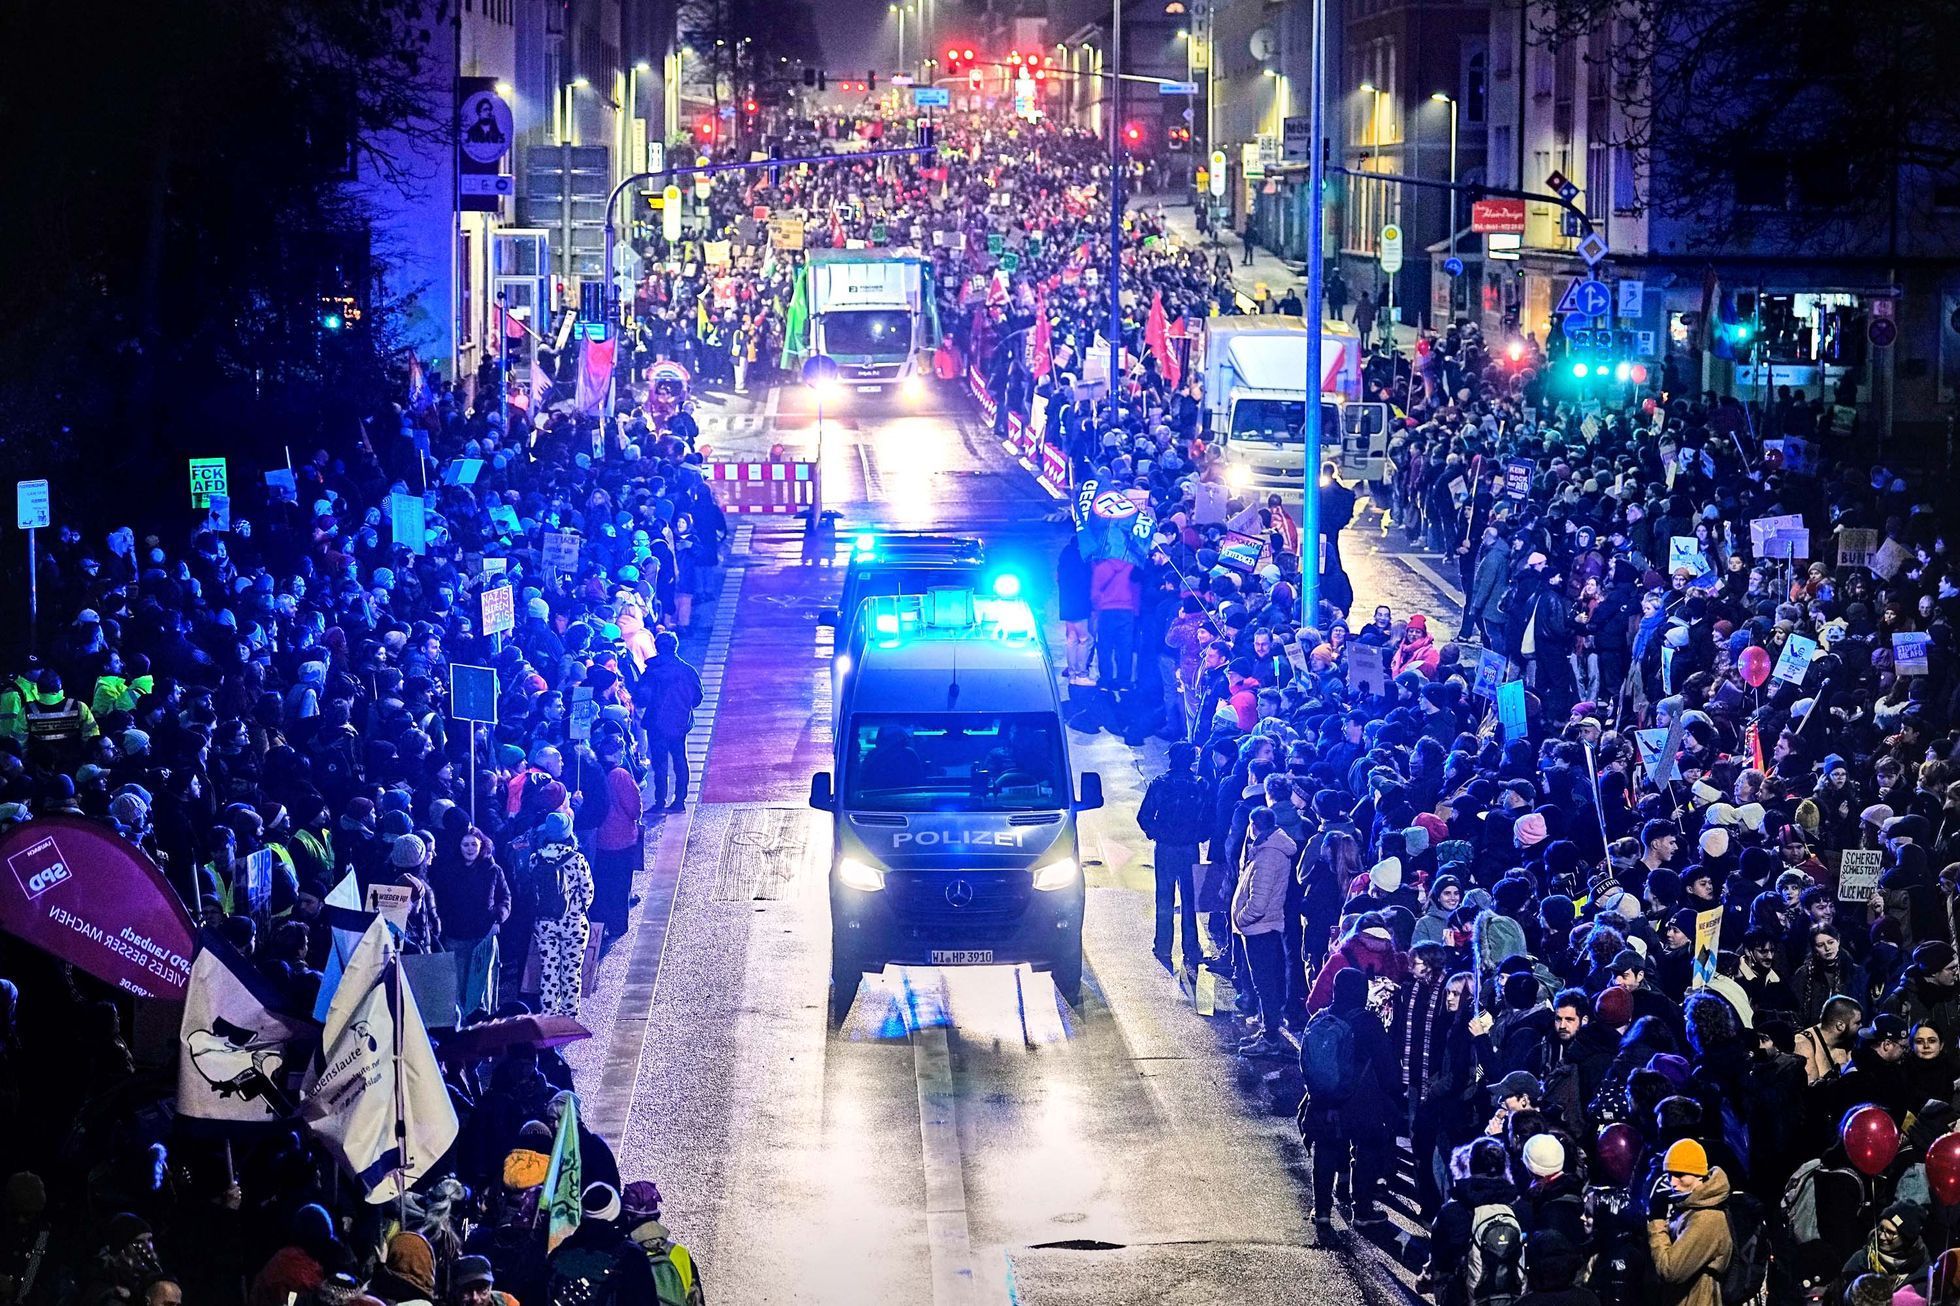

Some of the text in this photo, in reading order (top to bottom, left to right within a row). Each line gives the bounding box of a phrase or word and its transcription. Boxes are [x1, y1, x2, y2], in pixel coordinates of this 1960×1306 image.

[192, 468, 224, 480] FCK
[193, 479, 225, 492] AFD
[1842, 552, 1876, 565] BUNT
[482, 588, 509, 604] NAZIS
[485, 610, 510, 625] NAZIS
[892, 829, 1024, 848] POLIZEI
[1844, 851, 1881, 865] SCHEREN
[932, 951, 992, 963] WI HP 3910
